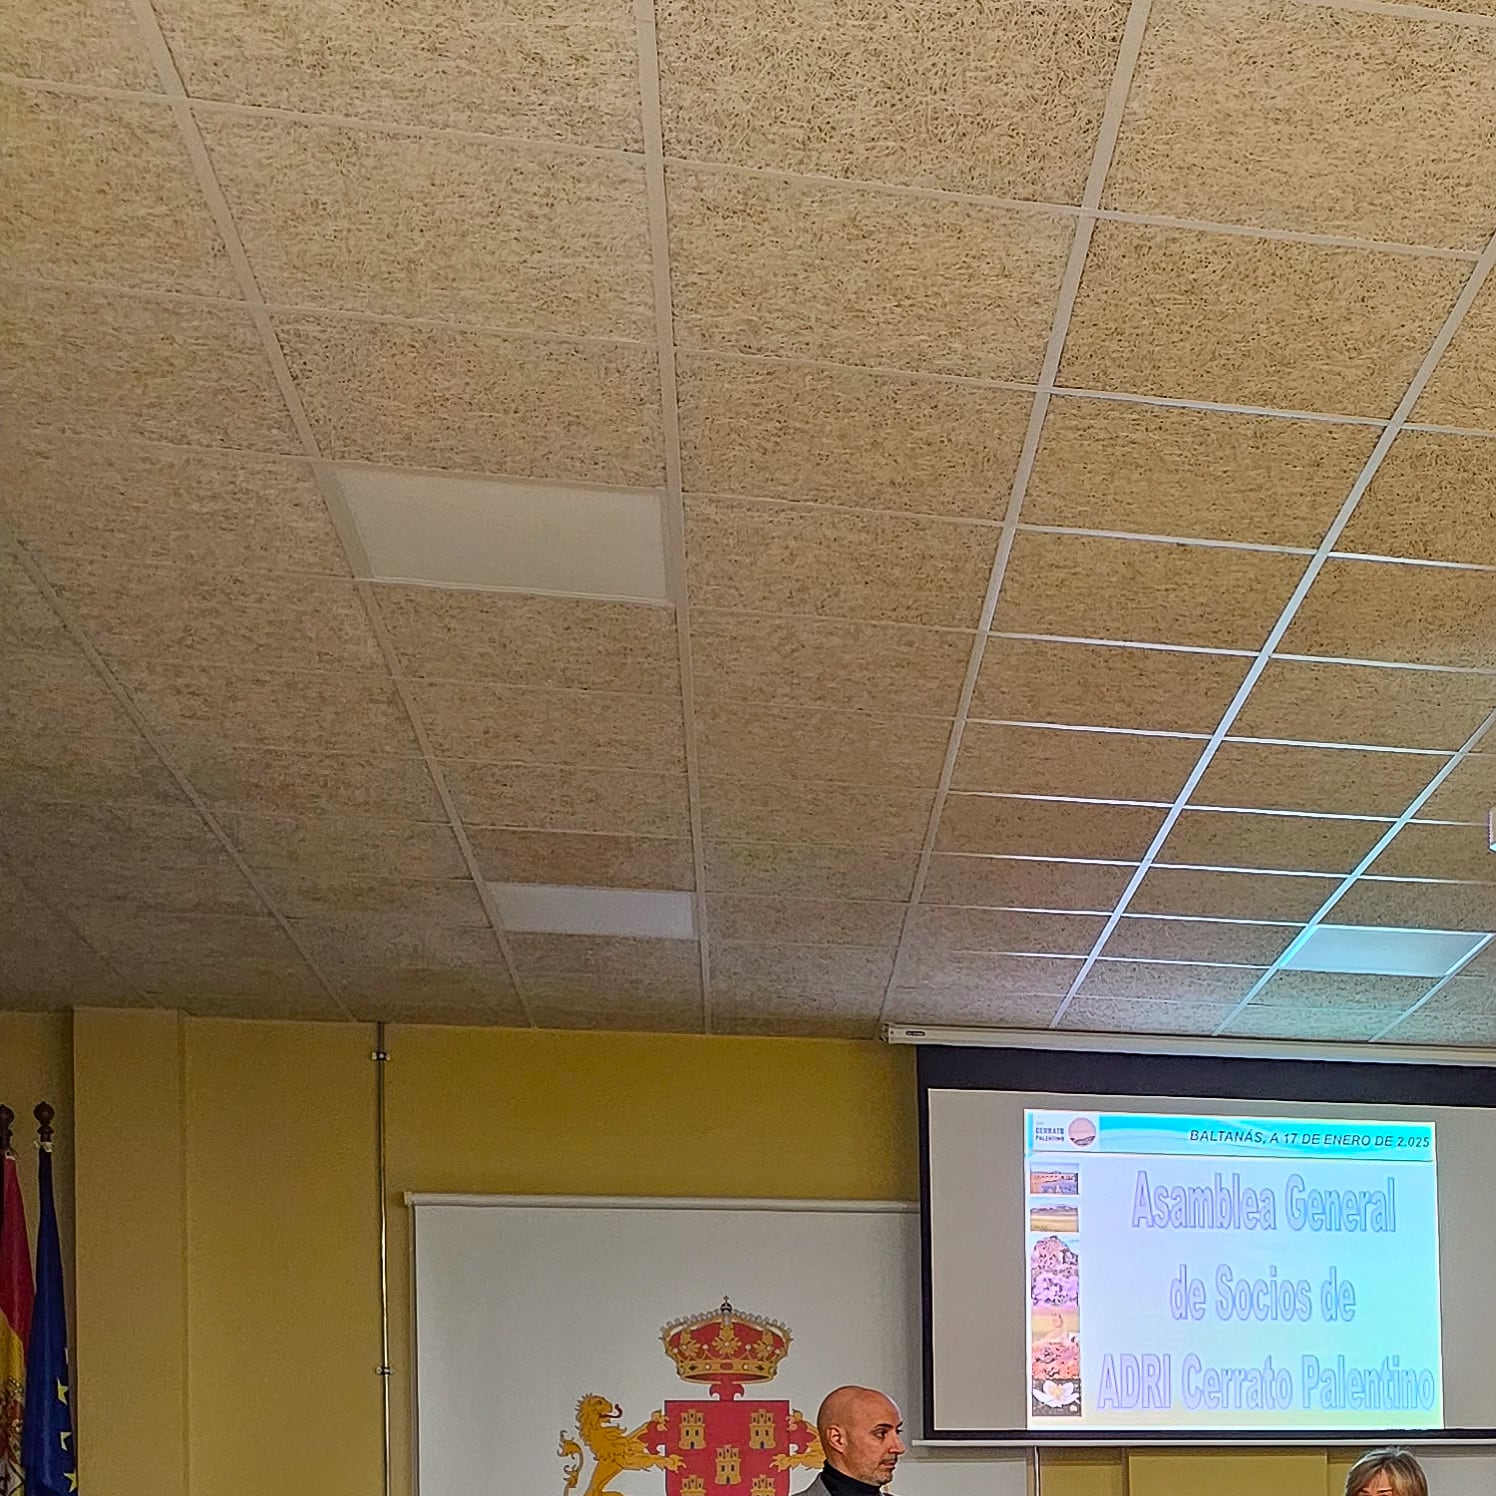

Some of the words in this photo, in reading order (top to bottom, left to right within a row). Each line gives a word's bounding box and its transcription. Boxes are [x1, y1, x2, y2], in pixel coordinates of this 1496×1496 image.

[1190, 1129, 1266, 1144] BALTANÁS,
[1269, 1133, 1279, 1144] A
[1285, 1133, 1297, 1144] 17
[1302, 1134, 1320, 1145] DE
[1324, 1134, 1371, 1146] ENERO
[1374, 1135, 1393, 1147] DE
[1397, 1136, 1430, 1148] 2.025
[1132, 1170, 1277, 1230] Asamblea
[1286, 1173, 1396, 1232] General
[1169, 1264, 1206, 1321] de
[1216, 1263, 1312, 1321] Socios
[1321, 1266, 1356, 1322] de
[1097, 1353, 1171, 1409] ADRI
[1182, 1352, 1293, 1410] Cerrato
[1302, 1354, 1435, 1411] Palentino
